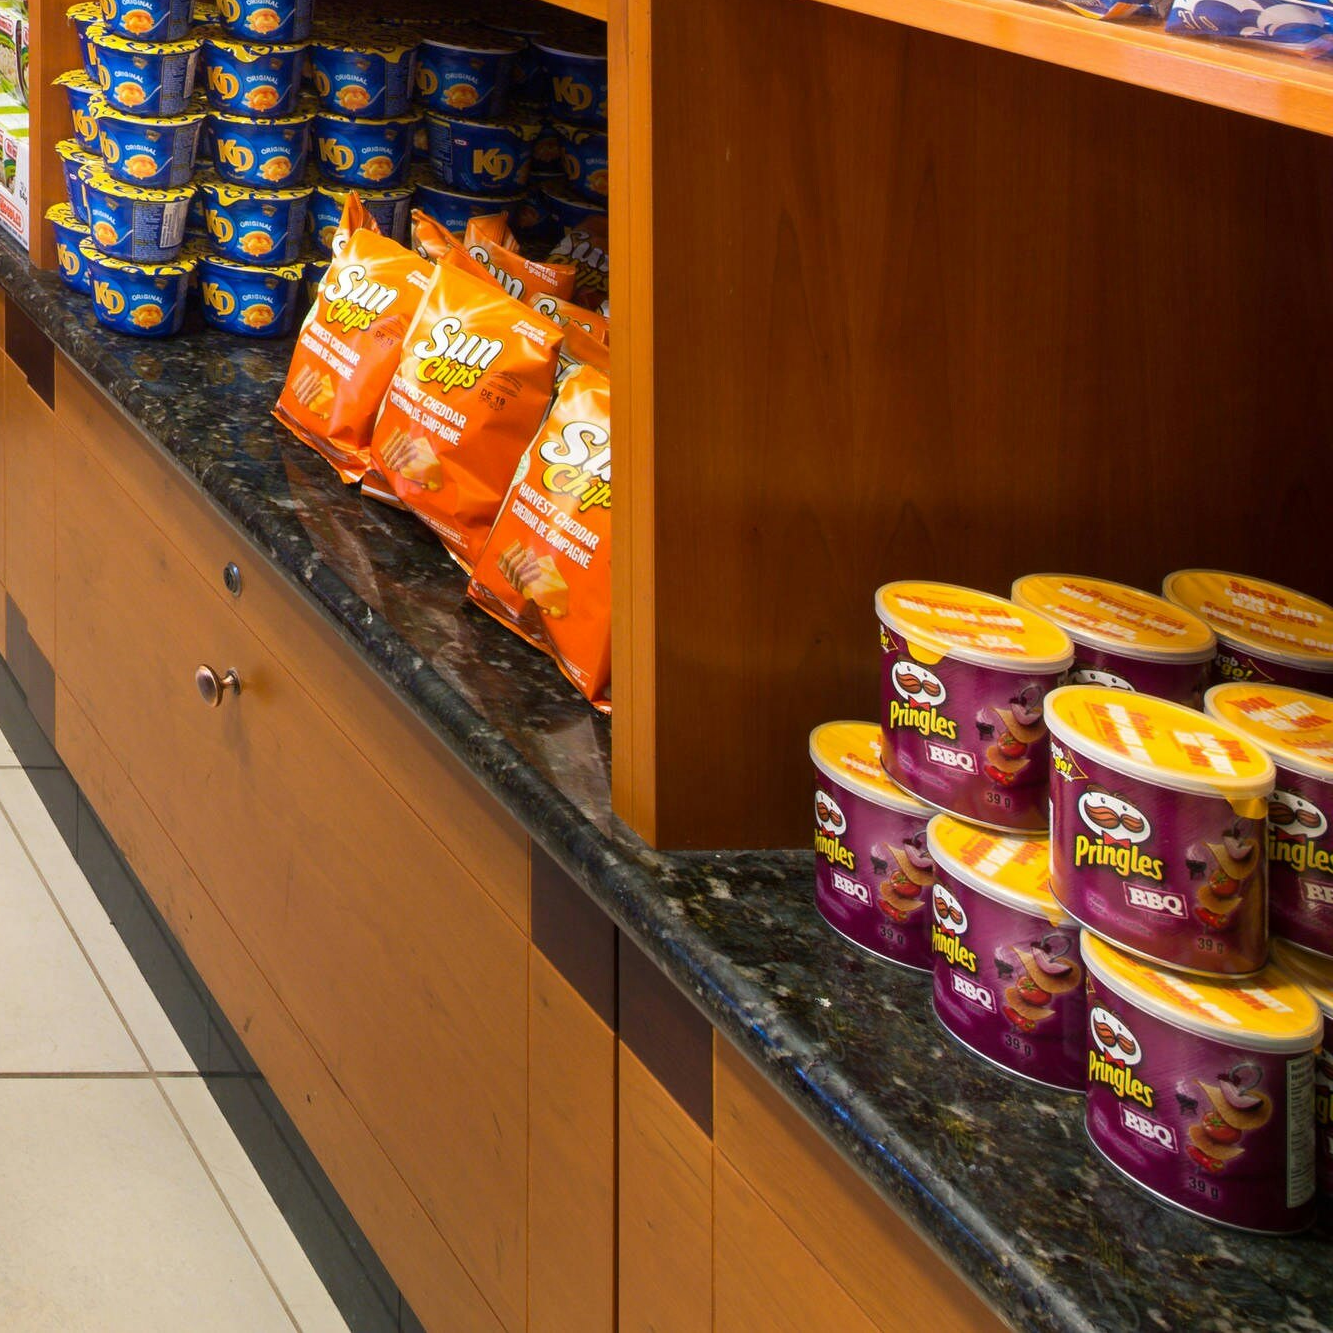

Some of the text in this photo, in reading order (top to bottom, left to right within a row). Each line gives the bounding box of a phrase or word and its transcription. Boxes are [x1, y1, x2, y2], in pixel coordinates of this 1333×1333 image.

[217, 140, 254, 172] KD
[318, 138, 355, 171] KD
[362, 145, 393, 156] ORIGINAL
[473, 147, 514, 178] KD
[93, 280, 125, 315] KD
[324, 265, 397, 314] Sun
[326, 299, 375, 333] Chips
[414, 317, 503, 369] Sun
[416, 357, 482, 393] Chips
[519, 482, 600, 550] HARVEST CHEDDAR
[511, 500, 592, 569] CHEDDAR DE CAMPAGNE
[889, 701, 957, 739] Pringles
[928, 746, 973, 768] BBQ
[986, 792, 1011, 808] 39 g
[1075, 836, 1164, 881] Pringles
[833, 873, 868, 902] BBQ
[1128, 886, 1183, 916] BBQ
[953, 973, 993, 1010] BBQ
[1088, 1050, 1153, 1108] Pringles
[1124, 1110, 1174, 1147] BBQ
[1188, 1175, 1219, 1199] 39 g
